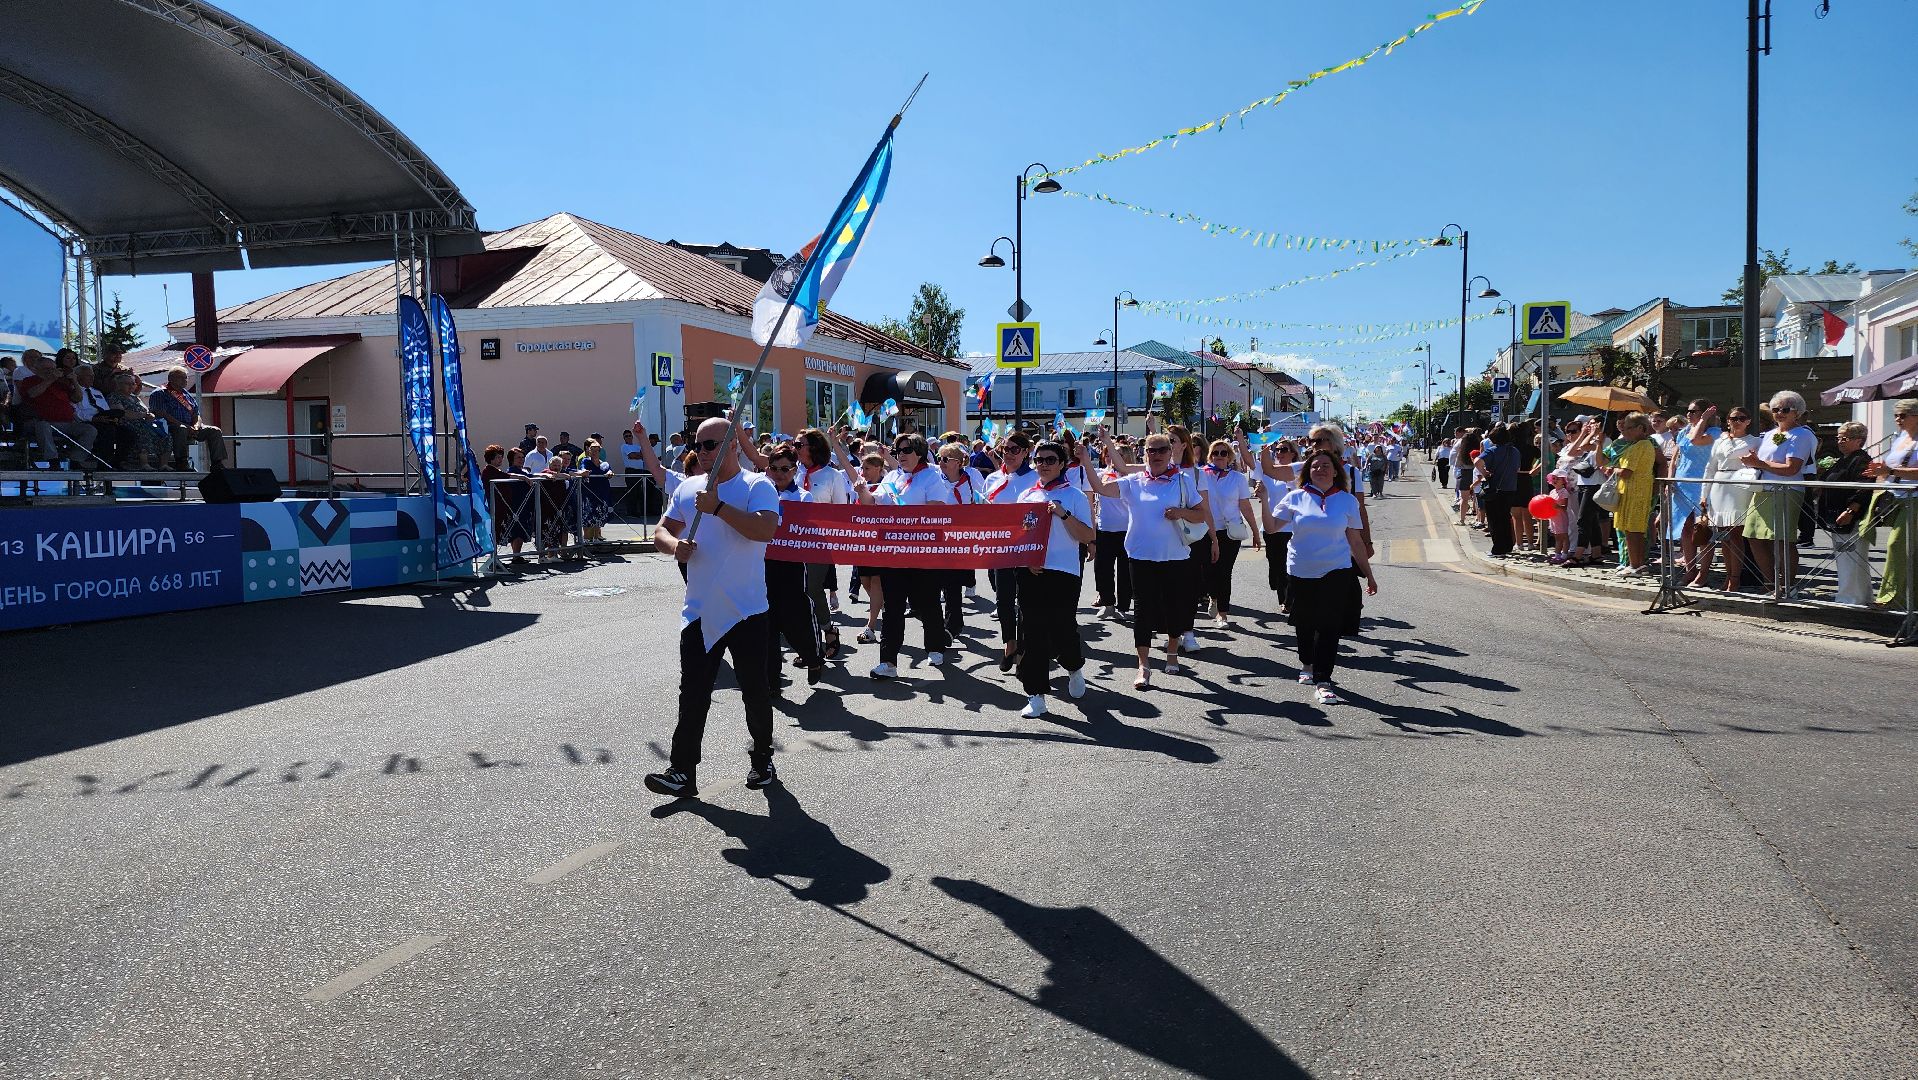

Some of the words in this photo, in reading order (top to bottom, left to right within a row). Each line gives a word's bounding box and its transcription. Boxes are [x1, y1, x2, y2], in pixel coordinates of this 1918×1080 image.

[514, 341, 573, 353] Городская
[574, 340, 595, 351] еда
[805, 356, 833, 373] КОВРЫ
[851, 515, 894, 525] Городской
[896, 516, 919, 526] округ
[920, 516, 952, 526] Кашира
[788, 523, 878, 539] Муниципальное
[885, 531, 936, 541] казенное
[944, 529, 1012, 542] учреждение
[0, 540, 25, 556] 13
[36, 527, 176, 562] КАШИРА
[184, 531, 205, 545] 56
[768, 537, 866, 553] жведомственная
[867, 543, 970, 555] централизованная
[972, 543, 1044, 557] бухгалтерия»
[0, 584, 47, 610] ЕНЬ
[54, 576, 142, 602] ГОРОДА
[149, 573, 183, 593] 668
[188, 569, 222, 589] ЛЕТ
